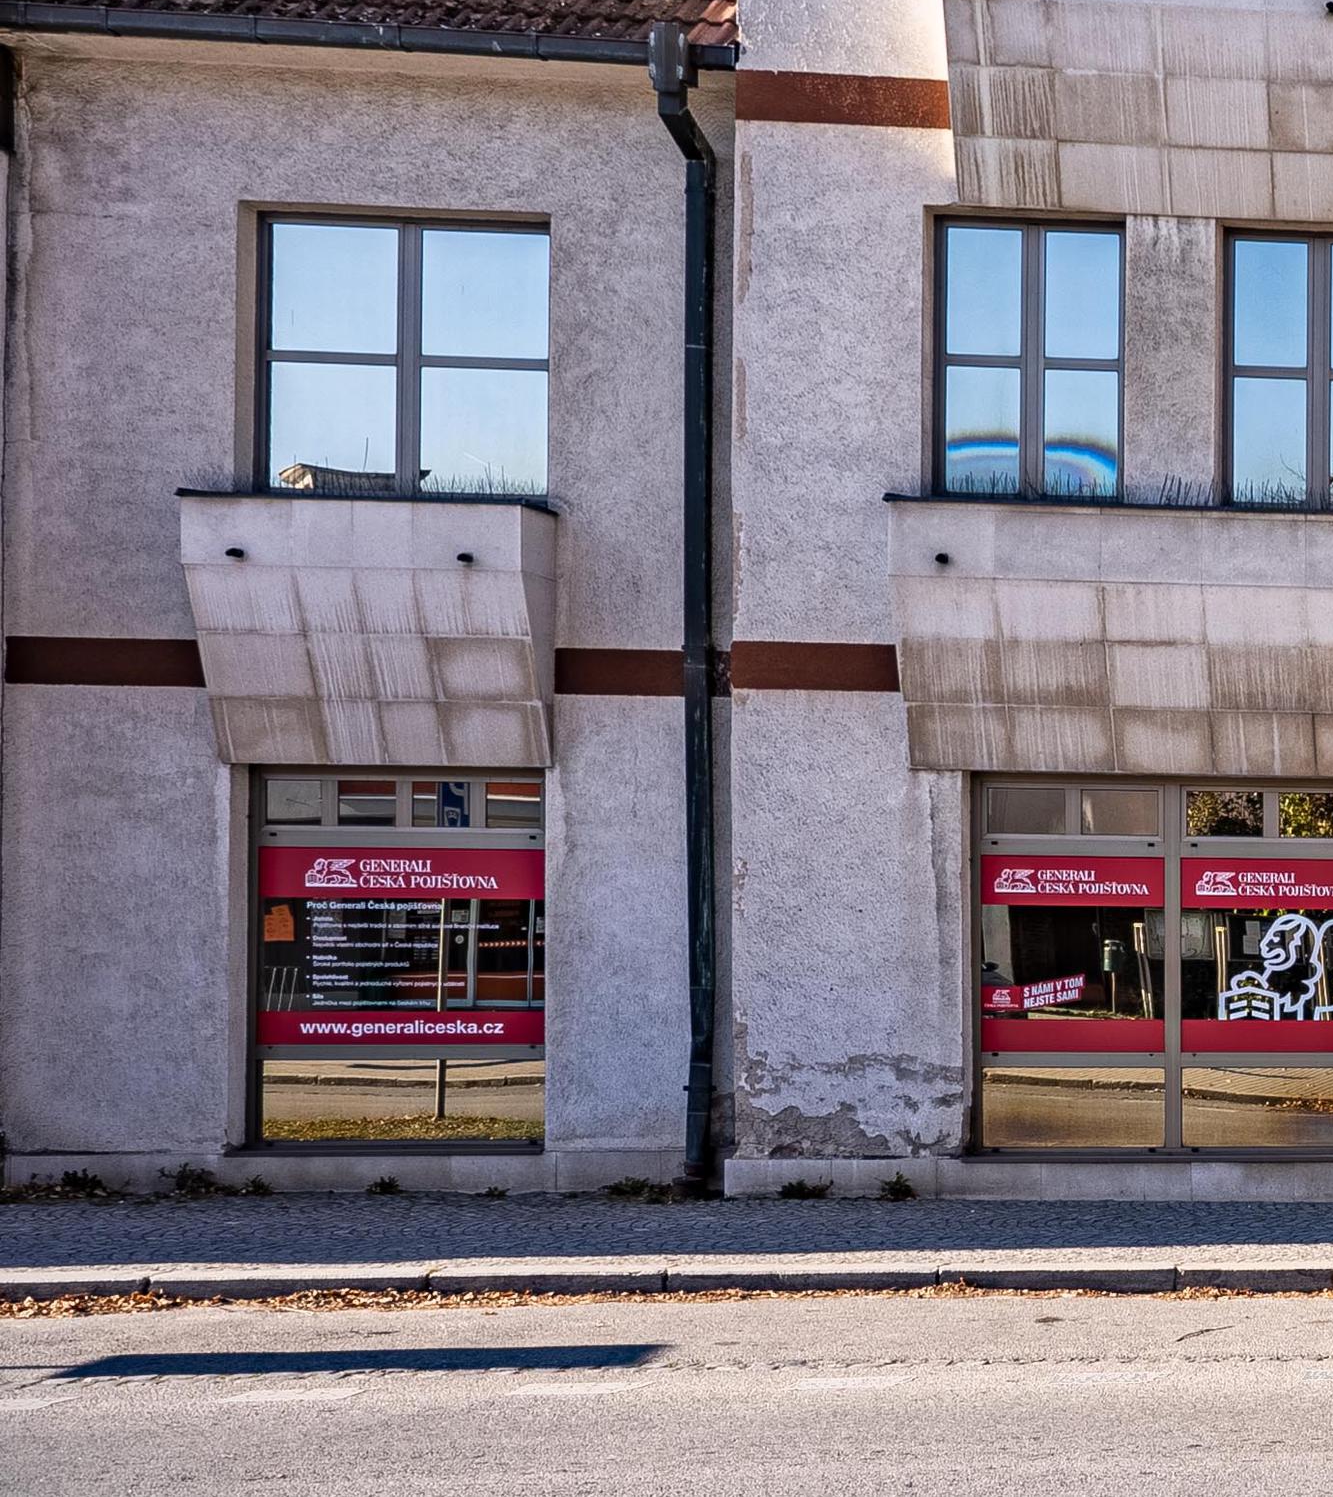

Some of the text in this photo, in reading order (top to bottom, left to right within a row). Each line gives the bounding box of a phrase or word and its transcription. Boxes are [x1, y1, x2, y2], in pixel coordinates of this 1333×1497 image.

[360, 859, 431, 872] GENERALI
[360, 873, 498, 889] ČESKÁ POJIŠŤOVNA
[1038, 870, 1095, 882] GENERALI
[1238, 873, 1295, 884] GENERALI
[1038, 881, 1149, 895] ČESKÁ POJIŠŤOVNA
[1238, 883, 1275, 897] ČESKÁ
[306, 901, 328, 909] Proč
[329, 901, 366, 909] Generali
[368, 900, 395, 909] Česká
[1024, 977, 1084, 997] S NÁMI V TOM
[1024, 989, 1079, 1008] NEJSTE SAMI
[300, 1019, 504, 1036] www.generaliceska.cz
